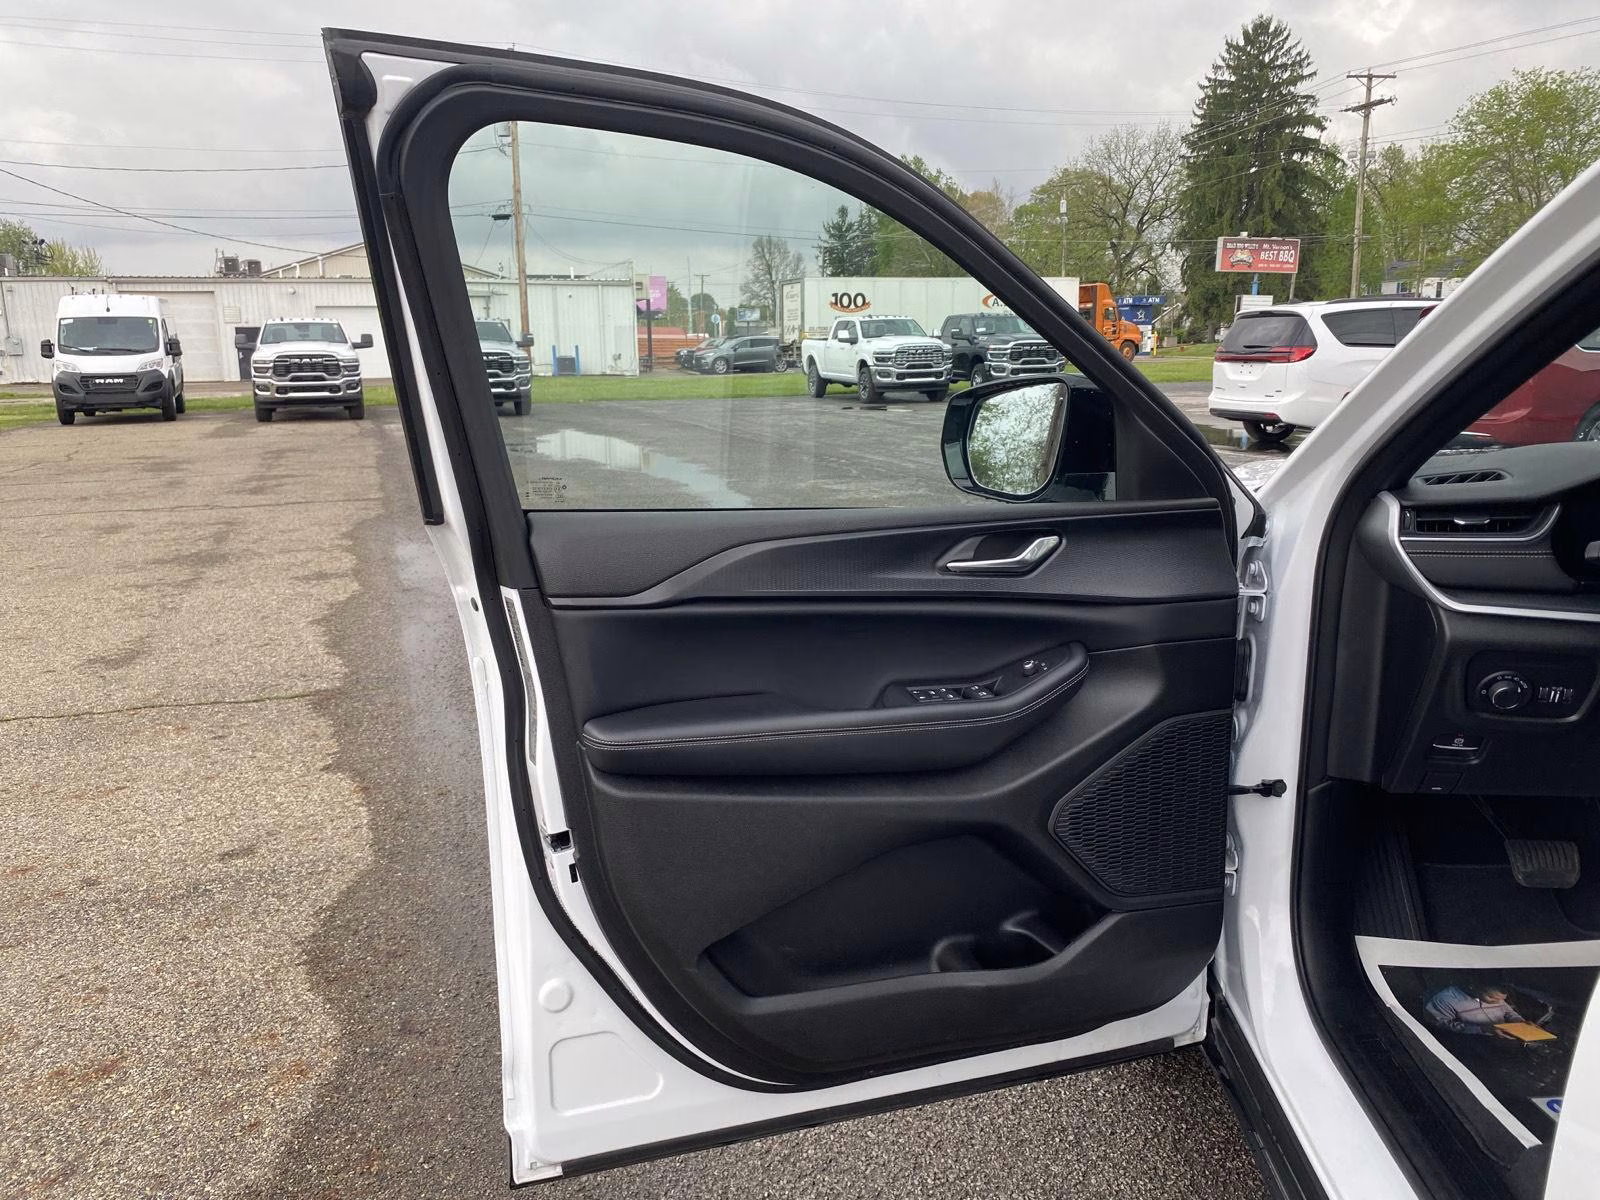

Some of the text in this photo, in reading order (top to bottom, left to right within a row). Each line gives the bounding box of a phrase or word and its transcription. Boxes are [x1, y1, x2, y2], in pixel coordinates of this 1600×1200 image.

[1260, 250, 1295, 263] BEST BBQ
[832, 292, 866, 308] 100
